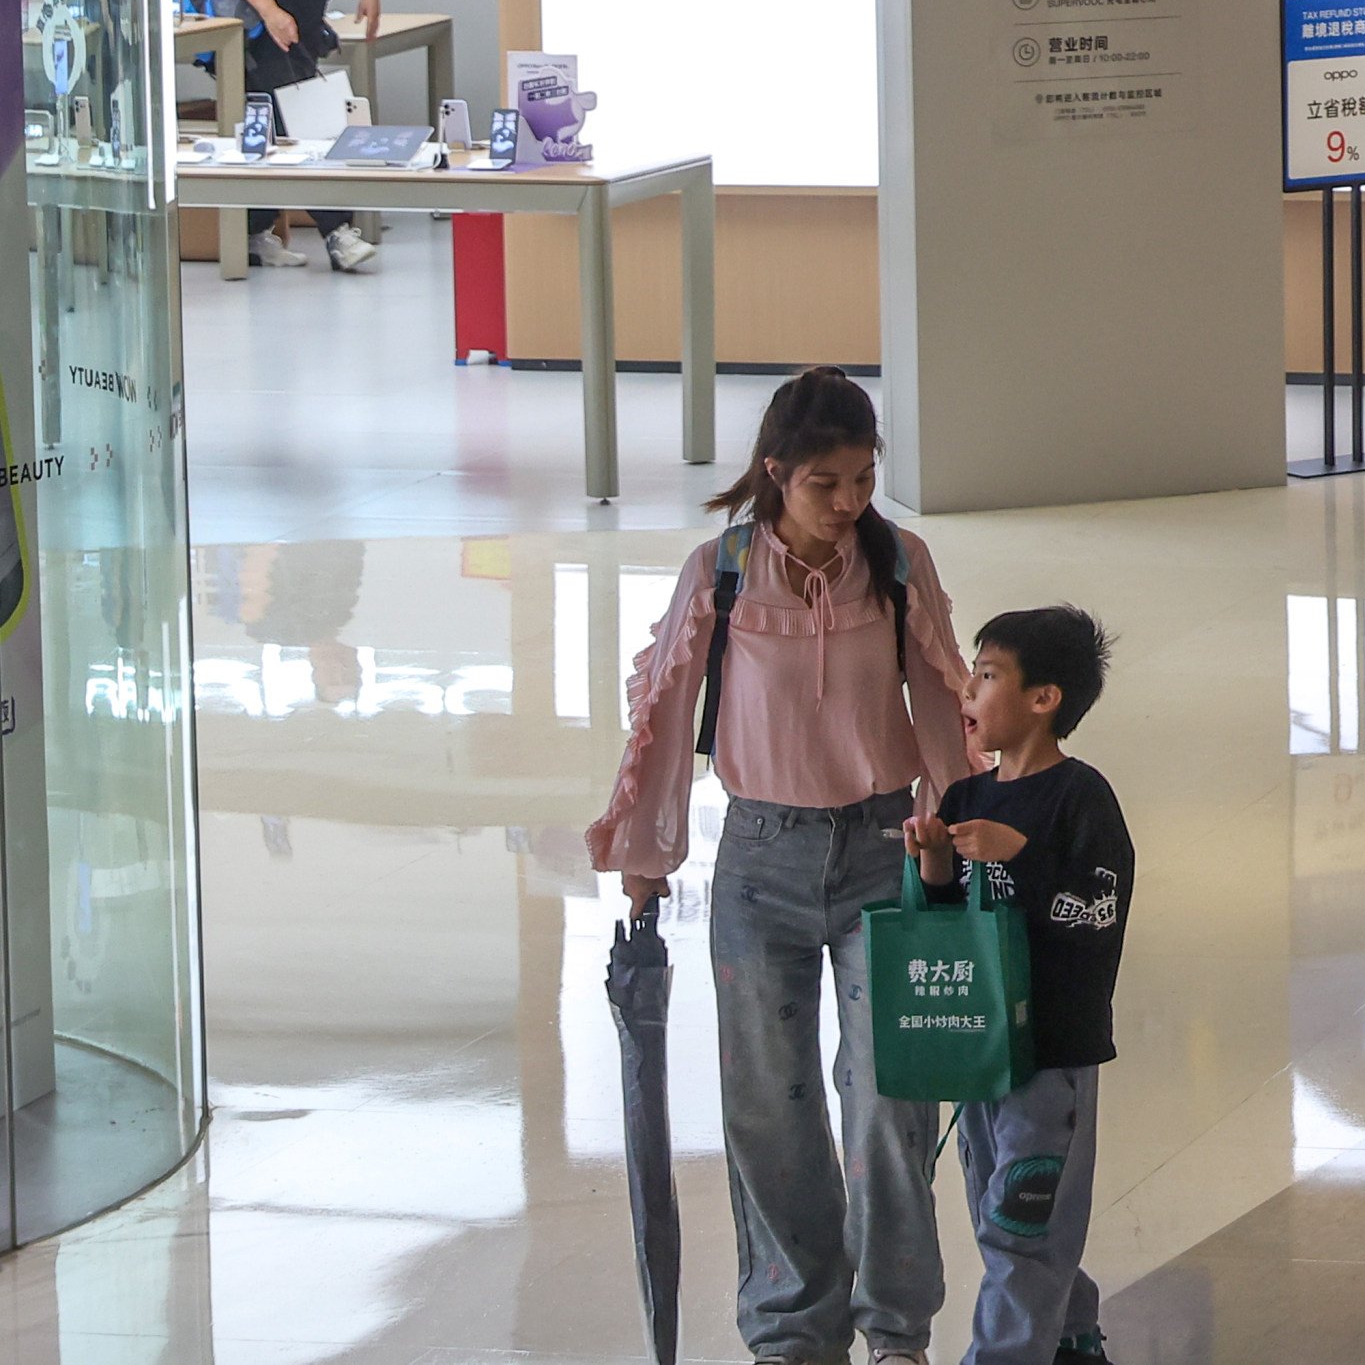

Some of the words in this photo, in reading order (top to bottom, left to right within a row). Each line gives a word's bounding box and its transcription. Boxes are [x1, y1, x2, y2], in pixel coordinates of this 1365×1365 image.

[1302, 11, 1319, 20] TAX
[1320, 8, 1352, 18] REFUND
[1049, 36, 1109, 53] 营业时间
[1324, 69, 1358, 81] oppo
[908, 959, 975, 983] 费大厨
[899, 1014, 986, 1028] 全国小炒肉大王
